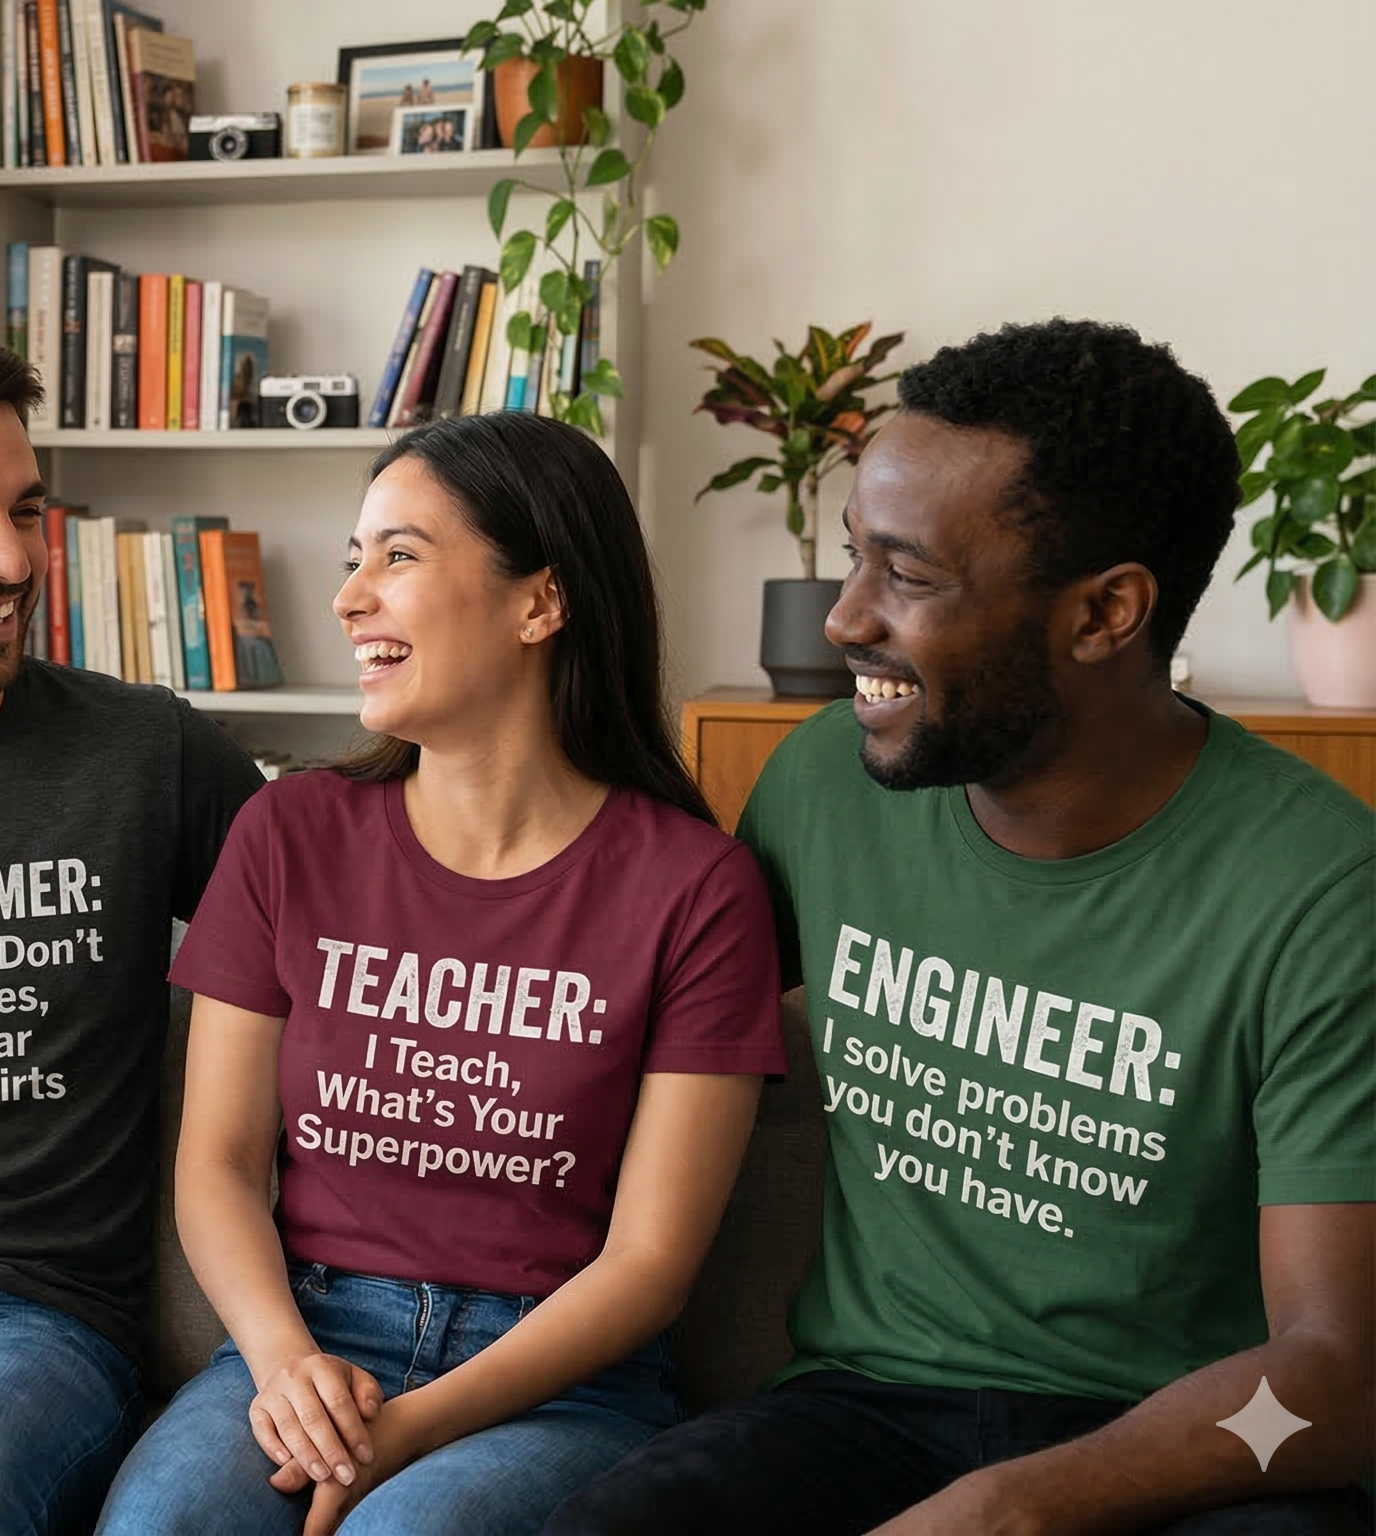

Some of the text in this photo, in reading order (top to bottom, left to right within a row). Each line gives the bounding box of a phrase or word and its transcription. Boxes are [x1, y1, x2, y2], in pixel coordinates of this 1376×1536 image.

[316, 937, 607, 1044] TEACHER:
[828, 923, 1181, 1106] ENGINEER:
[317, 1070, 564, 1140] What's Your
[365, 1034, 521, 1097] I Teach,
[823, 1017, 1167, 1161] I solve problems
[295, 1113, 576, 1187] Superpower?
[823, 1075, 1149, 1206] you don't know
[874, 1143, 1074, 1239] you have.
